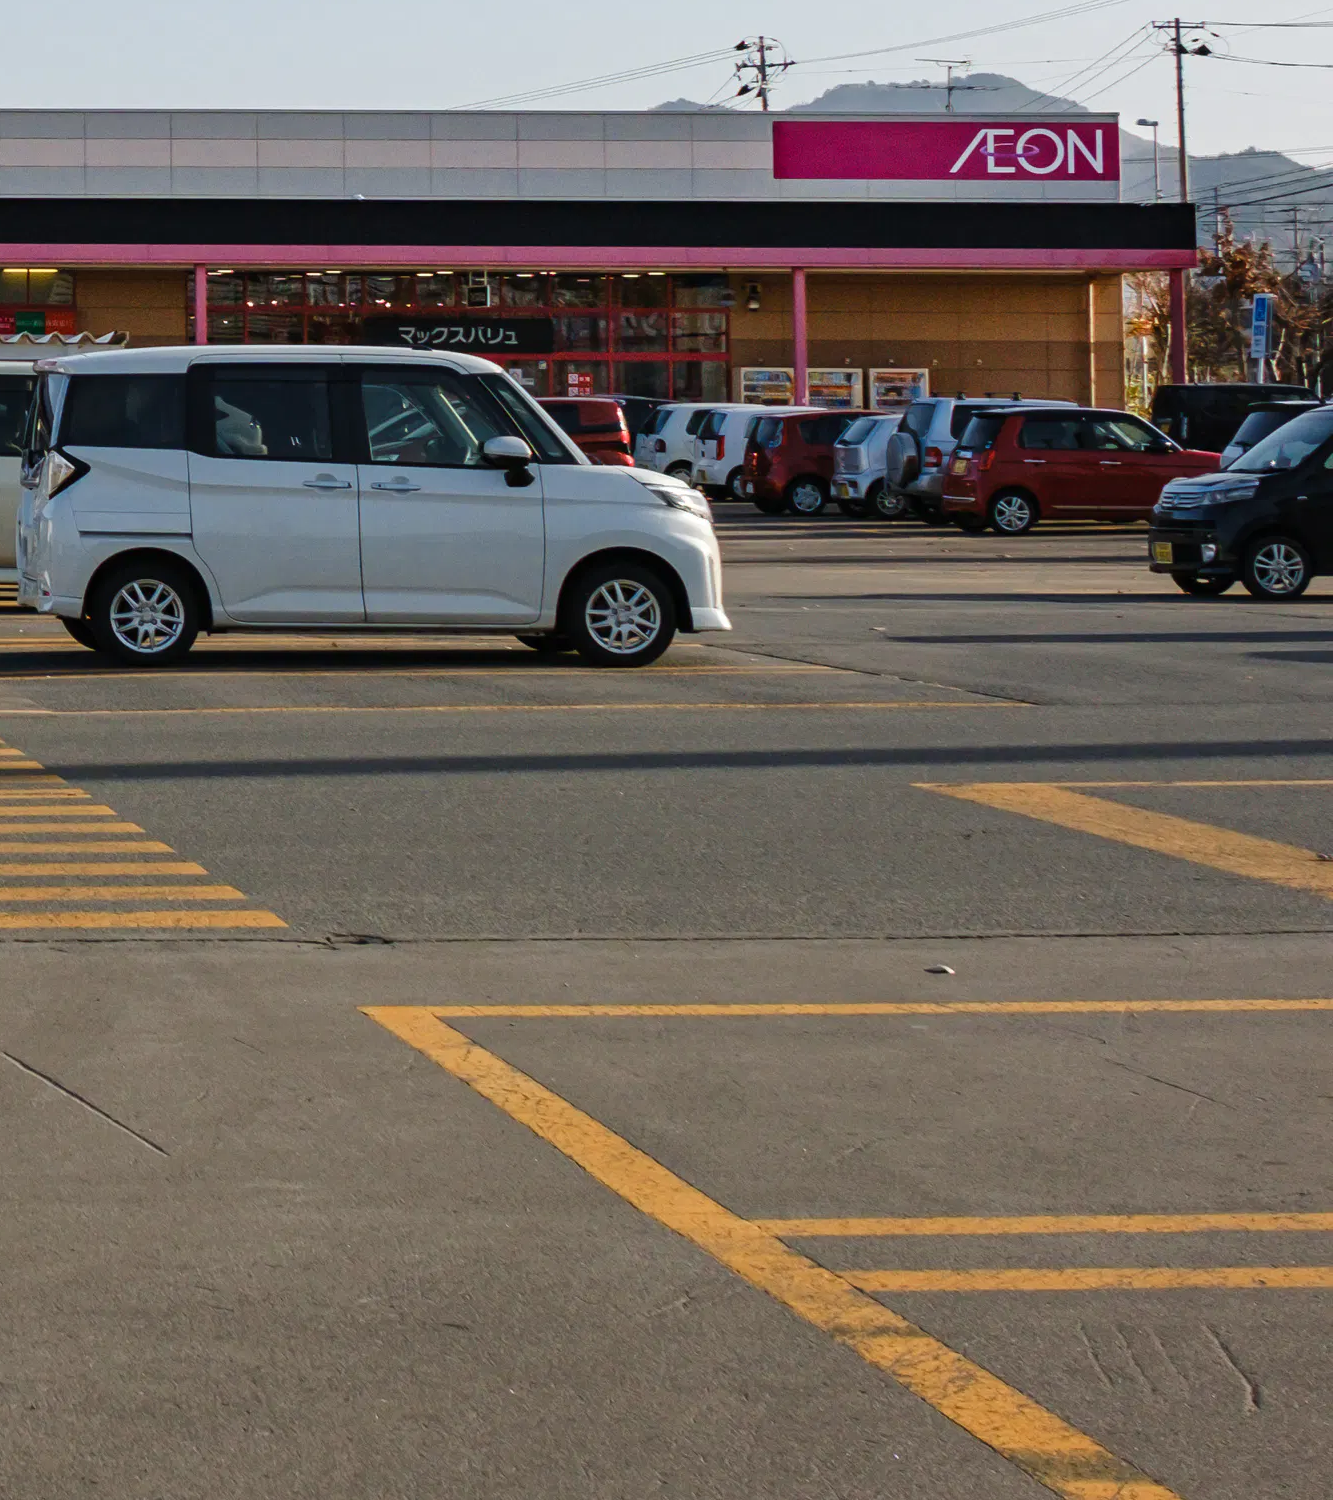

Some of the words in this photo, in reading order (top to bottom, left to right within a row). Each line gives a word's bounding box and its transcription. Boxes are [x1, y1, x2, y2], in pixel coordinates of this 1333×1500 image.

[398, 326, 518, 345] マックスバリュ
